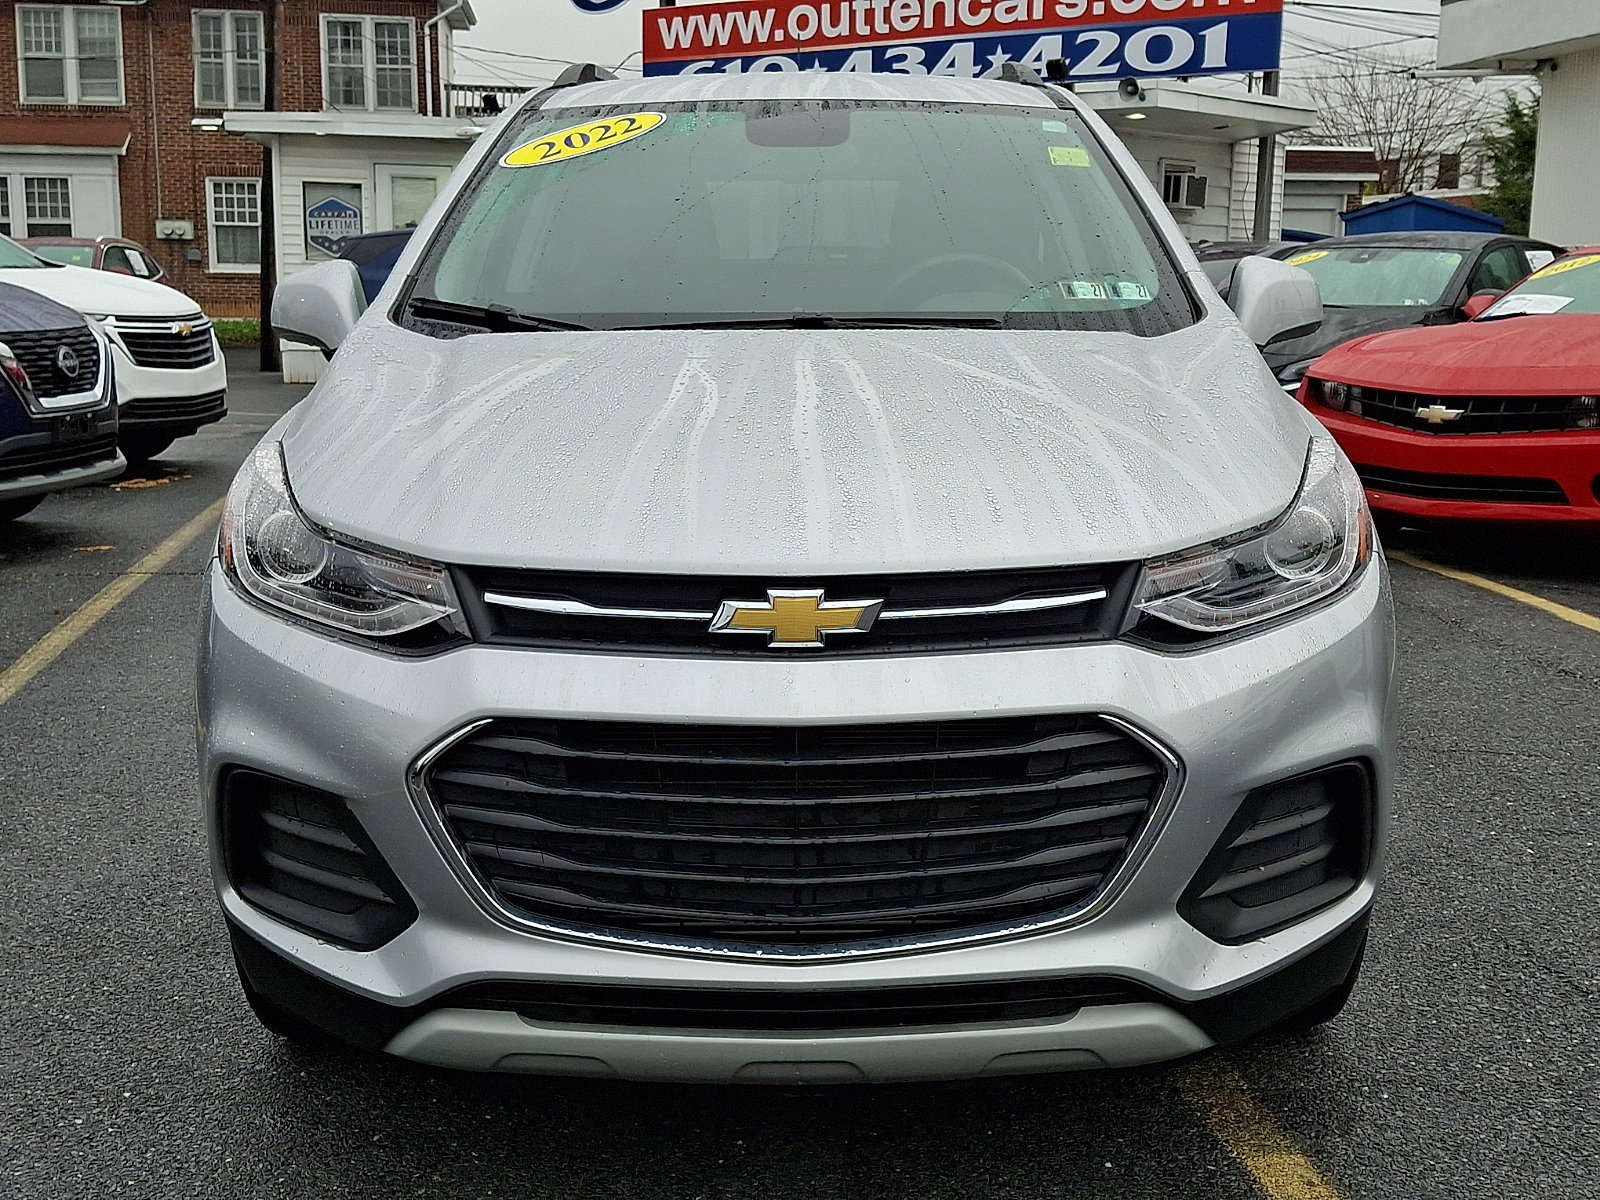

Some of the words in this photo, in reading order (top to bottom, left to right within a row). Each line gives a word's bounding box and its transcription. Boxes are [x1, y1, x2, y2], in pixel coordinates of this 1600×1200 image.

[658, 0, 1256, 49] www.outtencar.
[533, 117, 643, 161] 2022
[309, 220, 359, 230] LIFETIME
